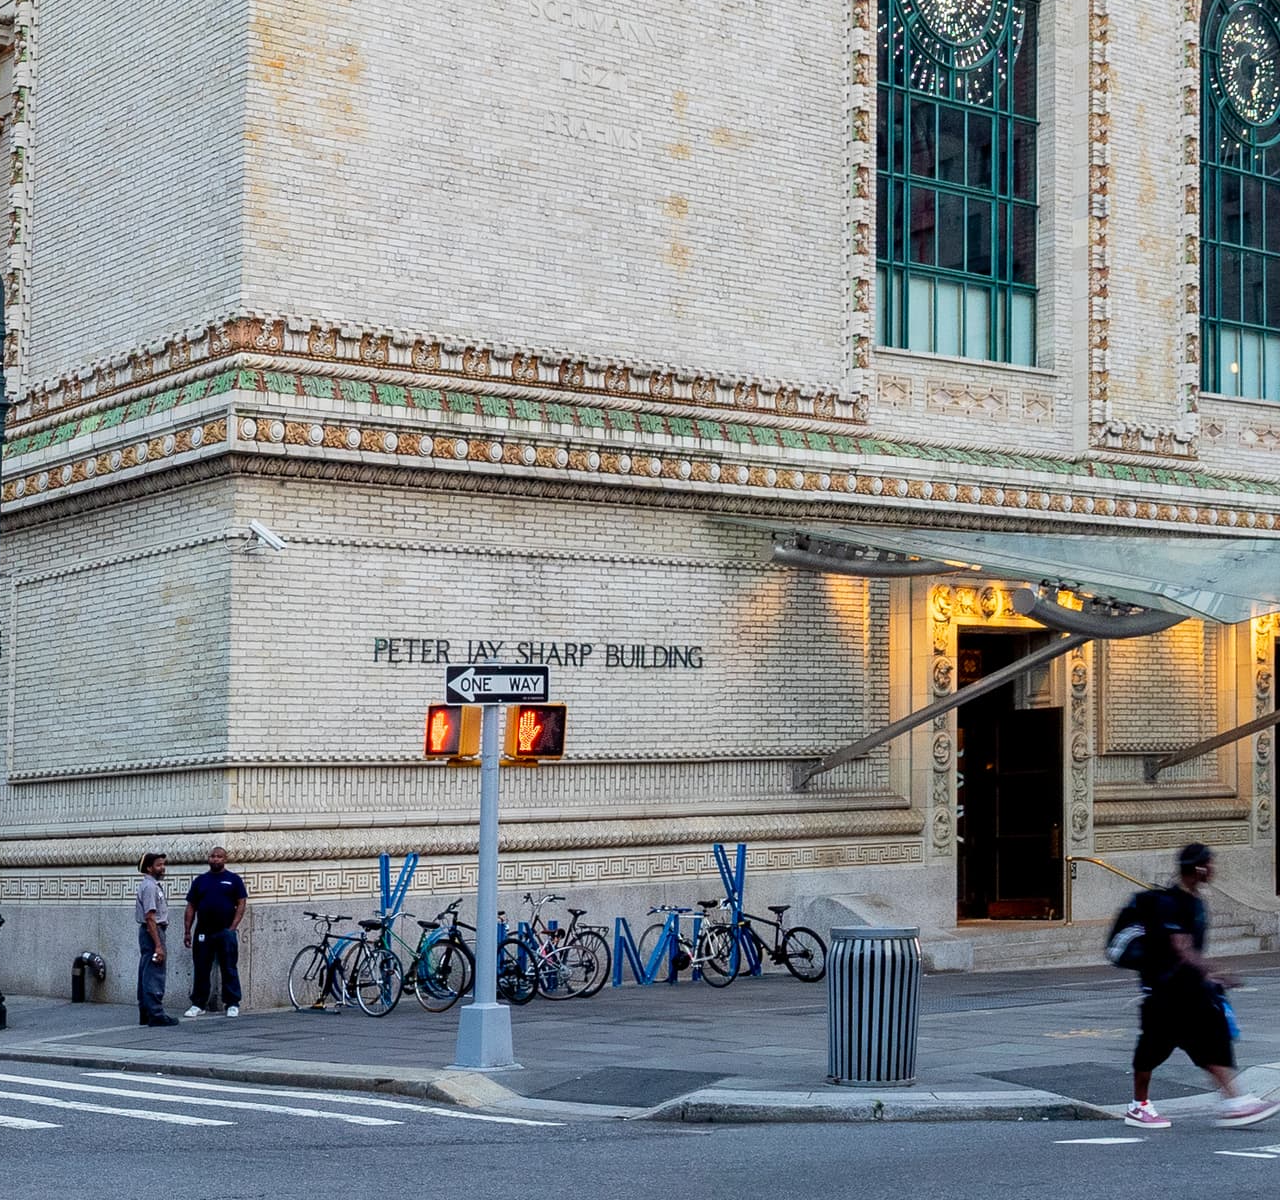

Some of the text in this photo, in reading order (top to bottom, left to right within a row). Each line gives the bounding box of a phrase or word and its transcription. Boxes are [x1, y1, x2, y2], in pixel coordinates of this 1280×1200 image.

[544, 110, 642, 151] BRAHMS
[373, 637, 704, 669] PETER JAY SHARP BUILDING
[460, 677, 540, 692] ONE WAY
